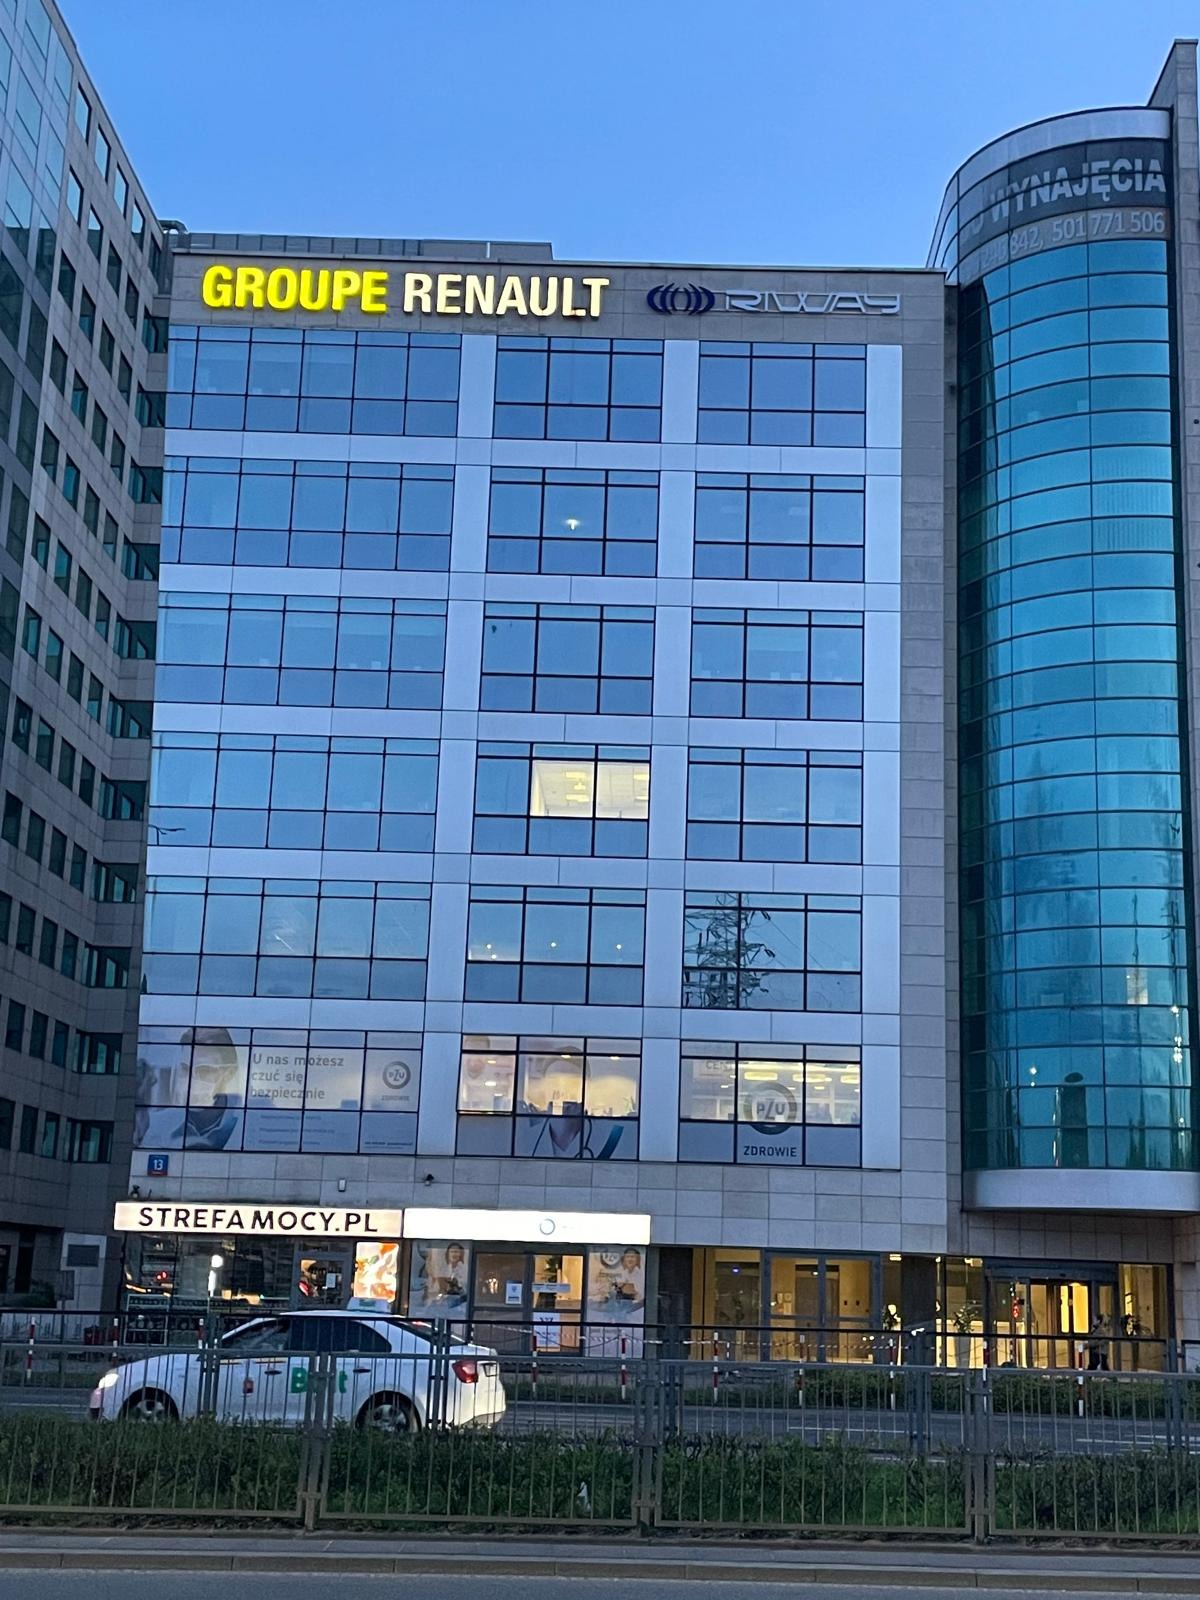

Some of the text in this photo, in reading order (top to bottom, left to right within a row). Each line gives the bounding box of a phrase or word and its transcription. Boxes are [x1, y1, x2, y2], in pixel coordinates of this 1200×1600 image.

[1053, 216, 1087, 241] 501
[1089, 212, 1126, 236] 771
[1130, 211, 1166, 233] 506
[202, 265, 610, 317] GROUPE RENAULT
[253, 1053, 344, 1067] U nas możesz
[251, 1069, 303, 1085] czuć się
[250, 1086, 325, 1100] bezpiecznie
[756, 1098, 786, 1121] PZU
[743, 1145, 797, 1158] ZDROWIE
[153, 1159, 164, 1171] 13
[138, 1207, 378, 1233] STREFAMOCY.PL
[291, 1366, 348, 1393] Bt
